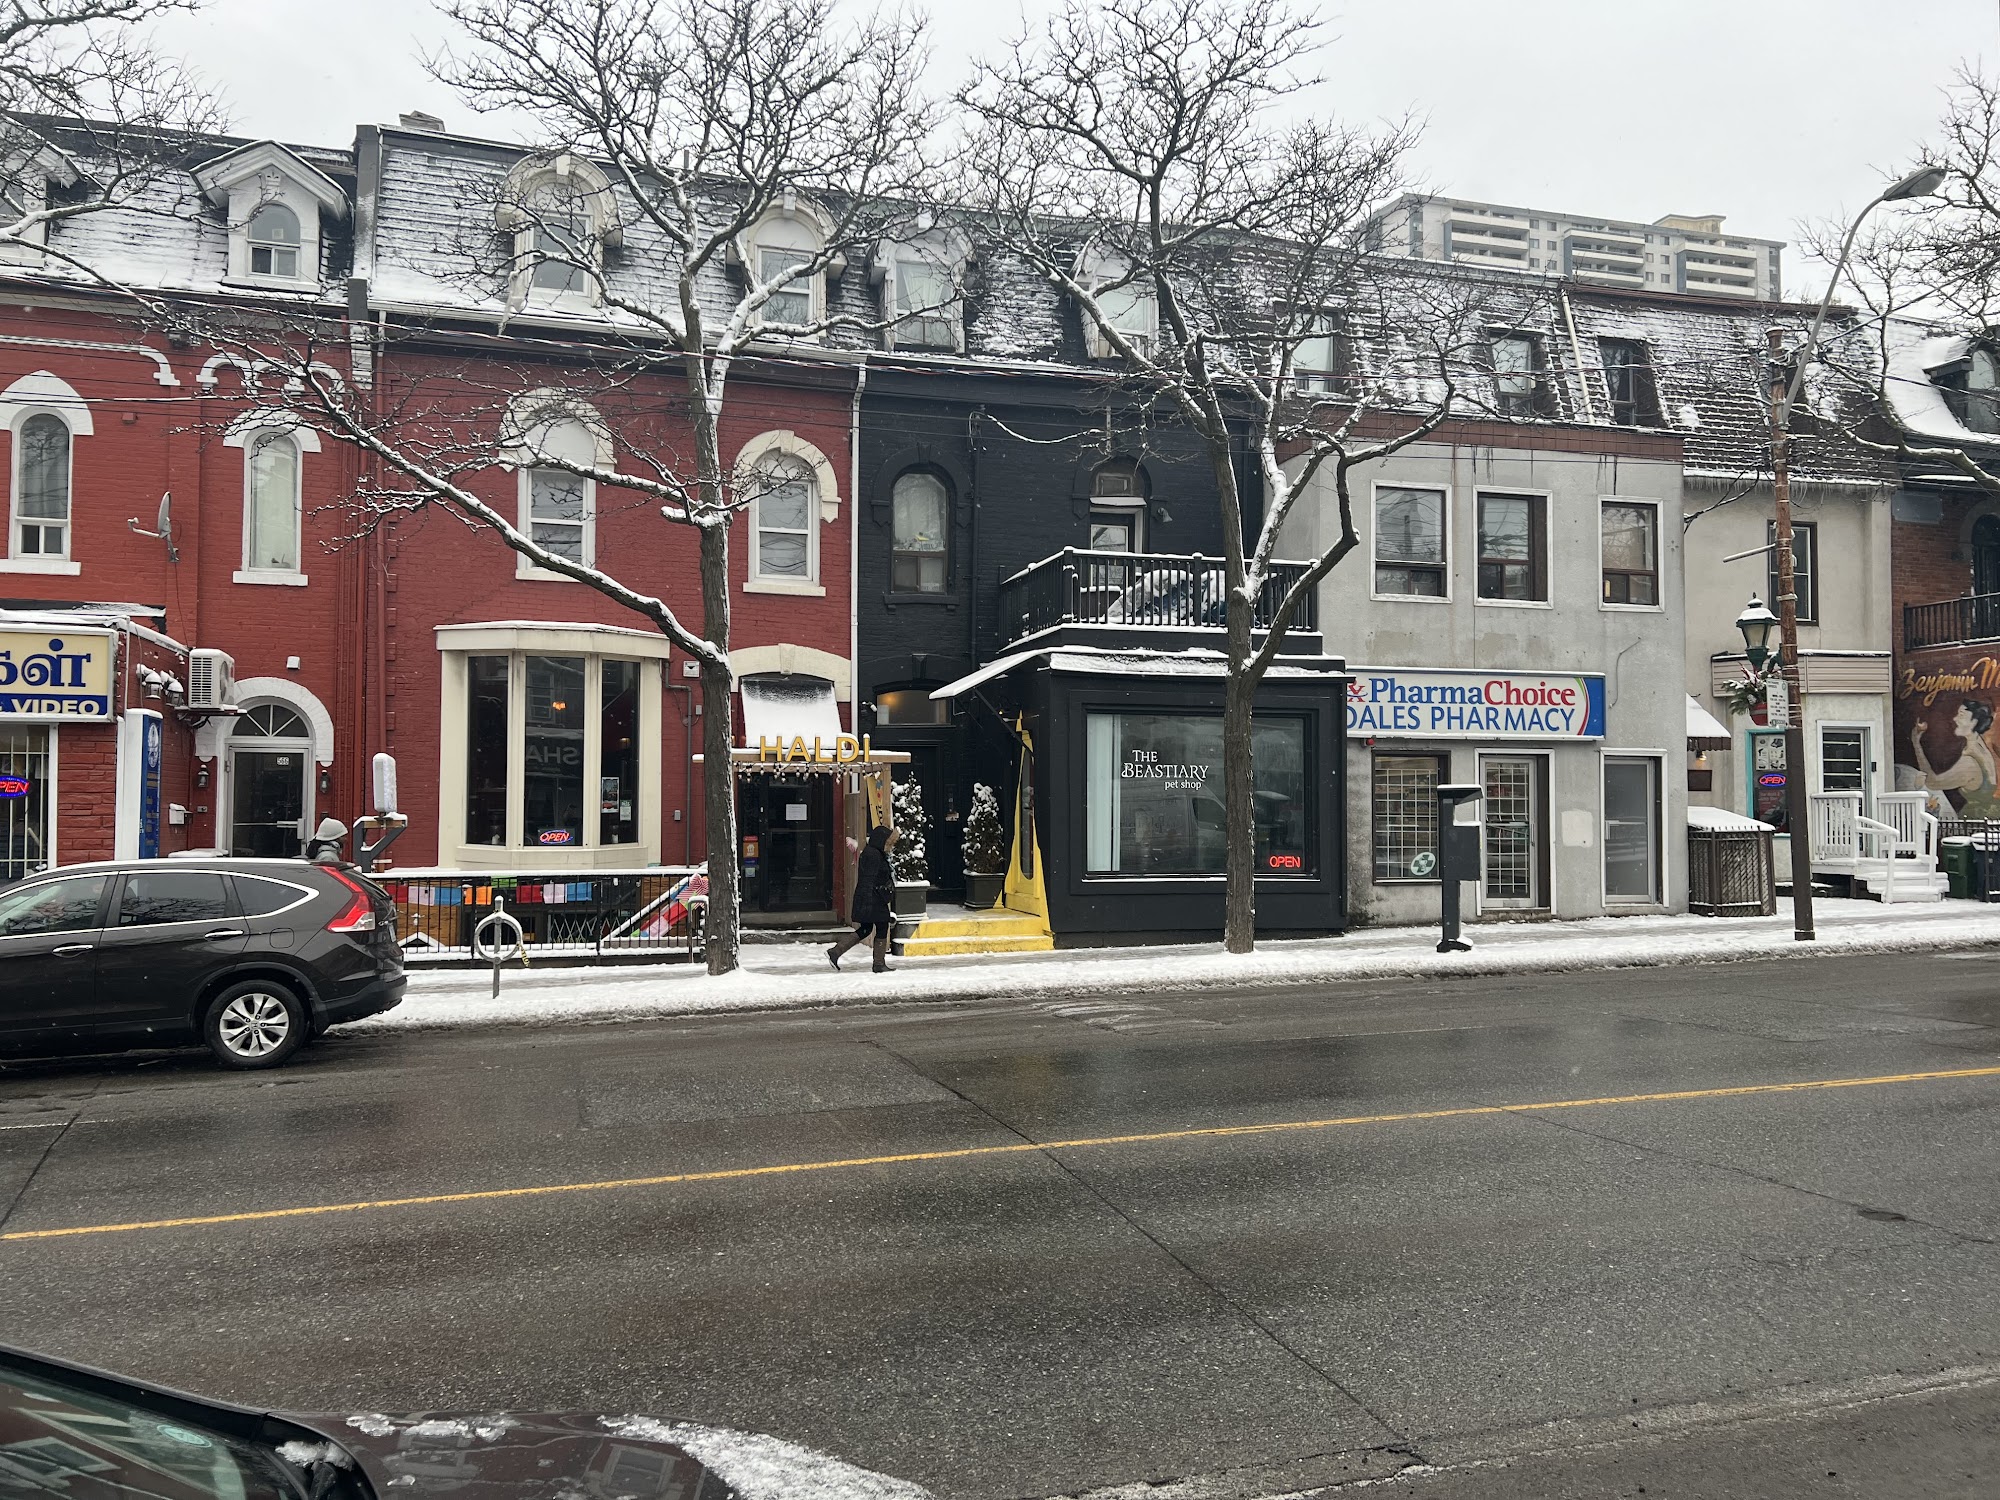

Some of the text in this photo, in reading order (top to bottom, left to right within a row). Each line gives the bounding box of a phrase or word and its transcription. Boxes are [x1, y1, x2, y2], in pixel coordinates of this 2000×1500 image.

[1368, 678, 1576, 706] PharmaChoice
[11, 698, 100, 716] VIDEO
[1431, 706, 1575, 732] PHARMACY
[760, 736, 870, 762] HALDI
[1132, 749, 1158, 762] THE
[1121, 762, 1209, 782] BEASTIARY
[1164, 780, 1202, 790] pet shop
[1759, 777, 1786, 785] OPEN
[540, 832, 569, 842] OPEN
[1269, 855, 1301, 868] OPEN
